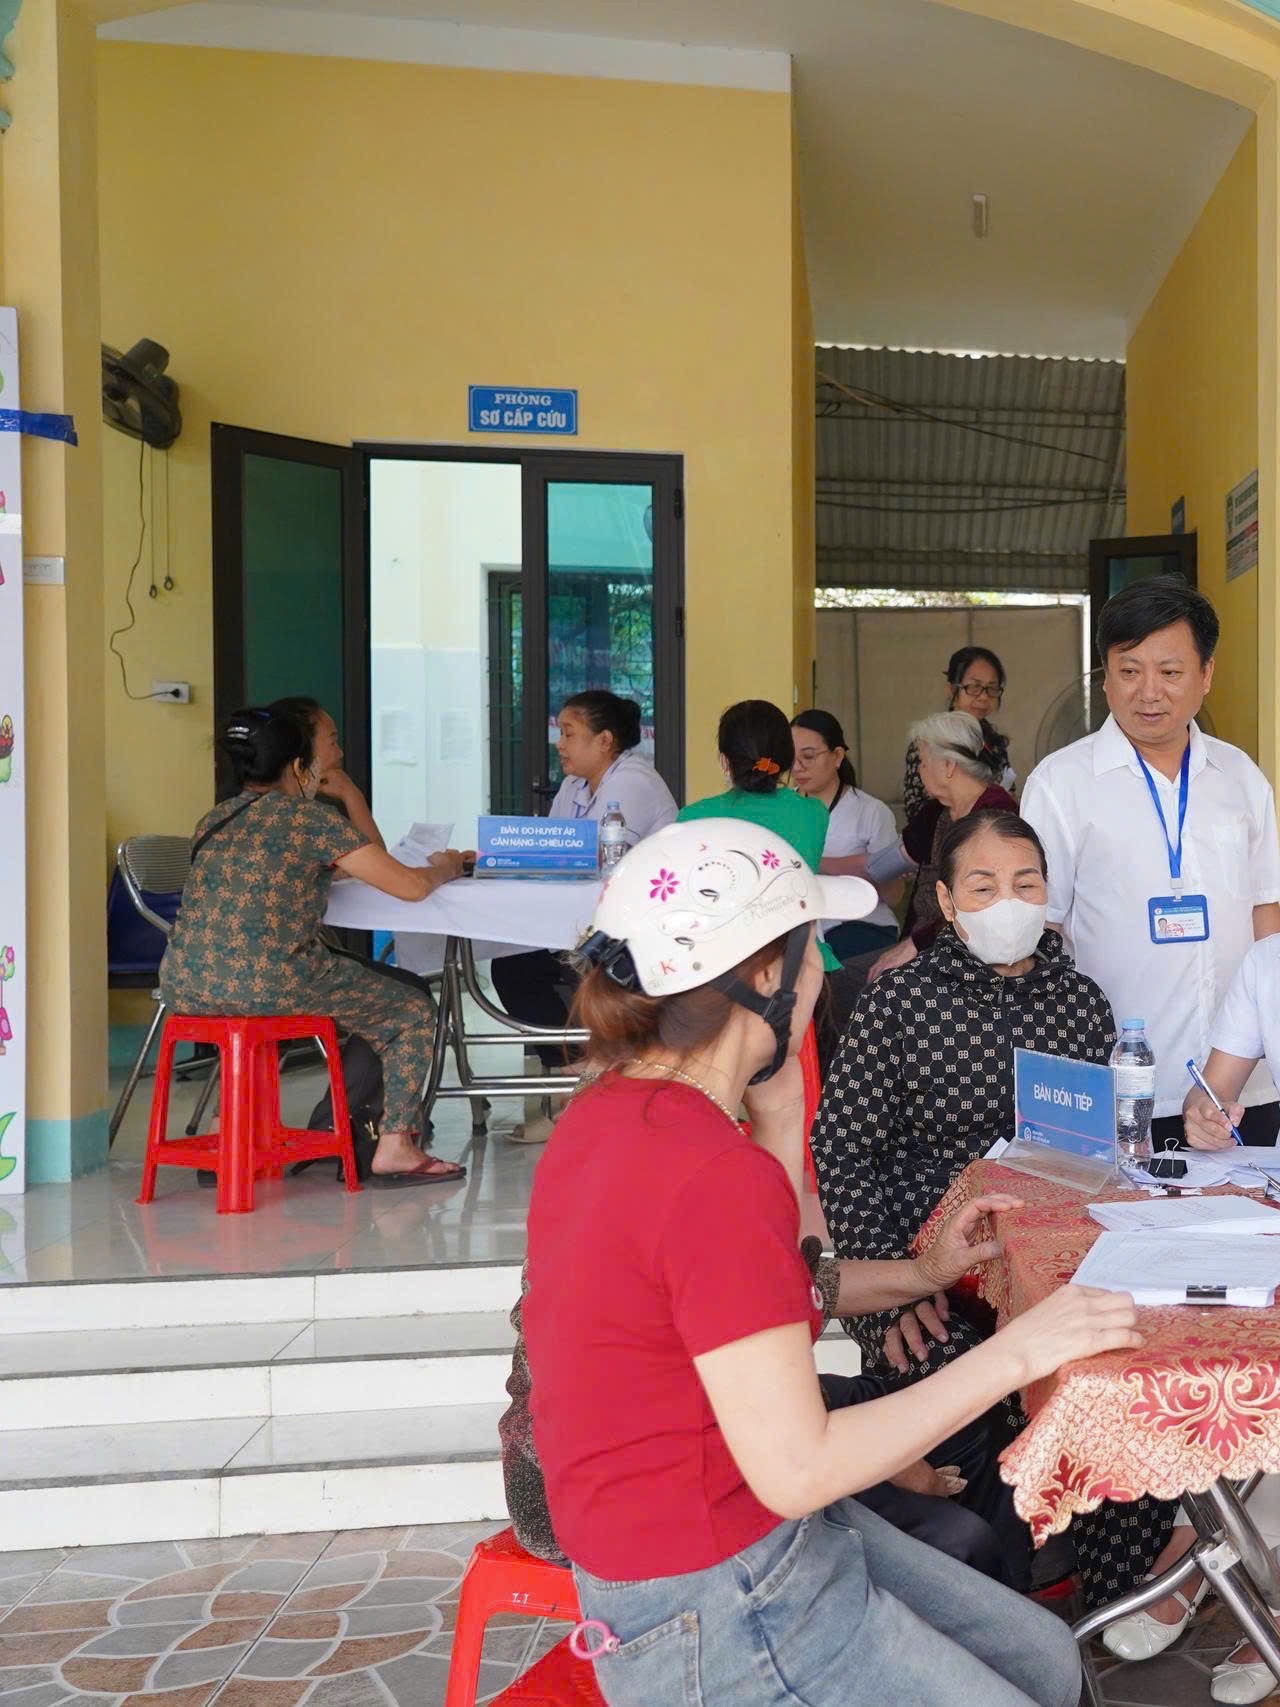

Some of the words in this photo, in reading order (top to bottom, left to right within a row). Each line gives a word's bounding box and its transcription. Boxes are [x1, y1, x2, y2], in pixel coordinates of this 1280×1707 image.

[495, 392, 552, 406] PHÒNG
[480, 409, 500, 425] SƠ
[504, 407, 533, 426] CẤP
[538, 410, 566, 428] CỨU
[501, 825, 518, 835] BÀN
[522, 827, 535, 835] ĐO
[535, 826, 563, 836] HUYẾT
[491, 837, 509, 846] CÂN
[565, 840, 584, 848] CAO
[1034, 1082, 1052, 1103] BÀN
[1053, 1087, 1072, 1108] ĐÓN
[1074, 1093, 1093, 1112] TIẾP
